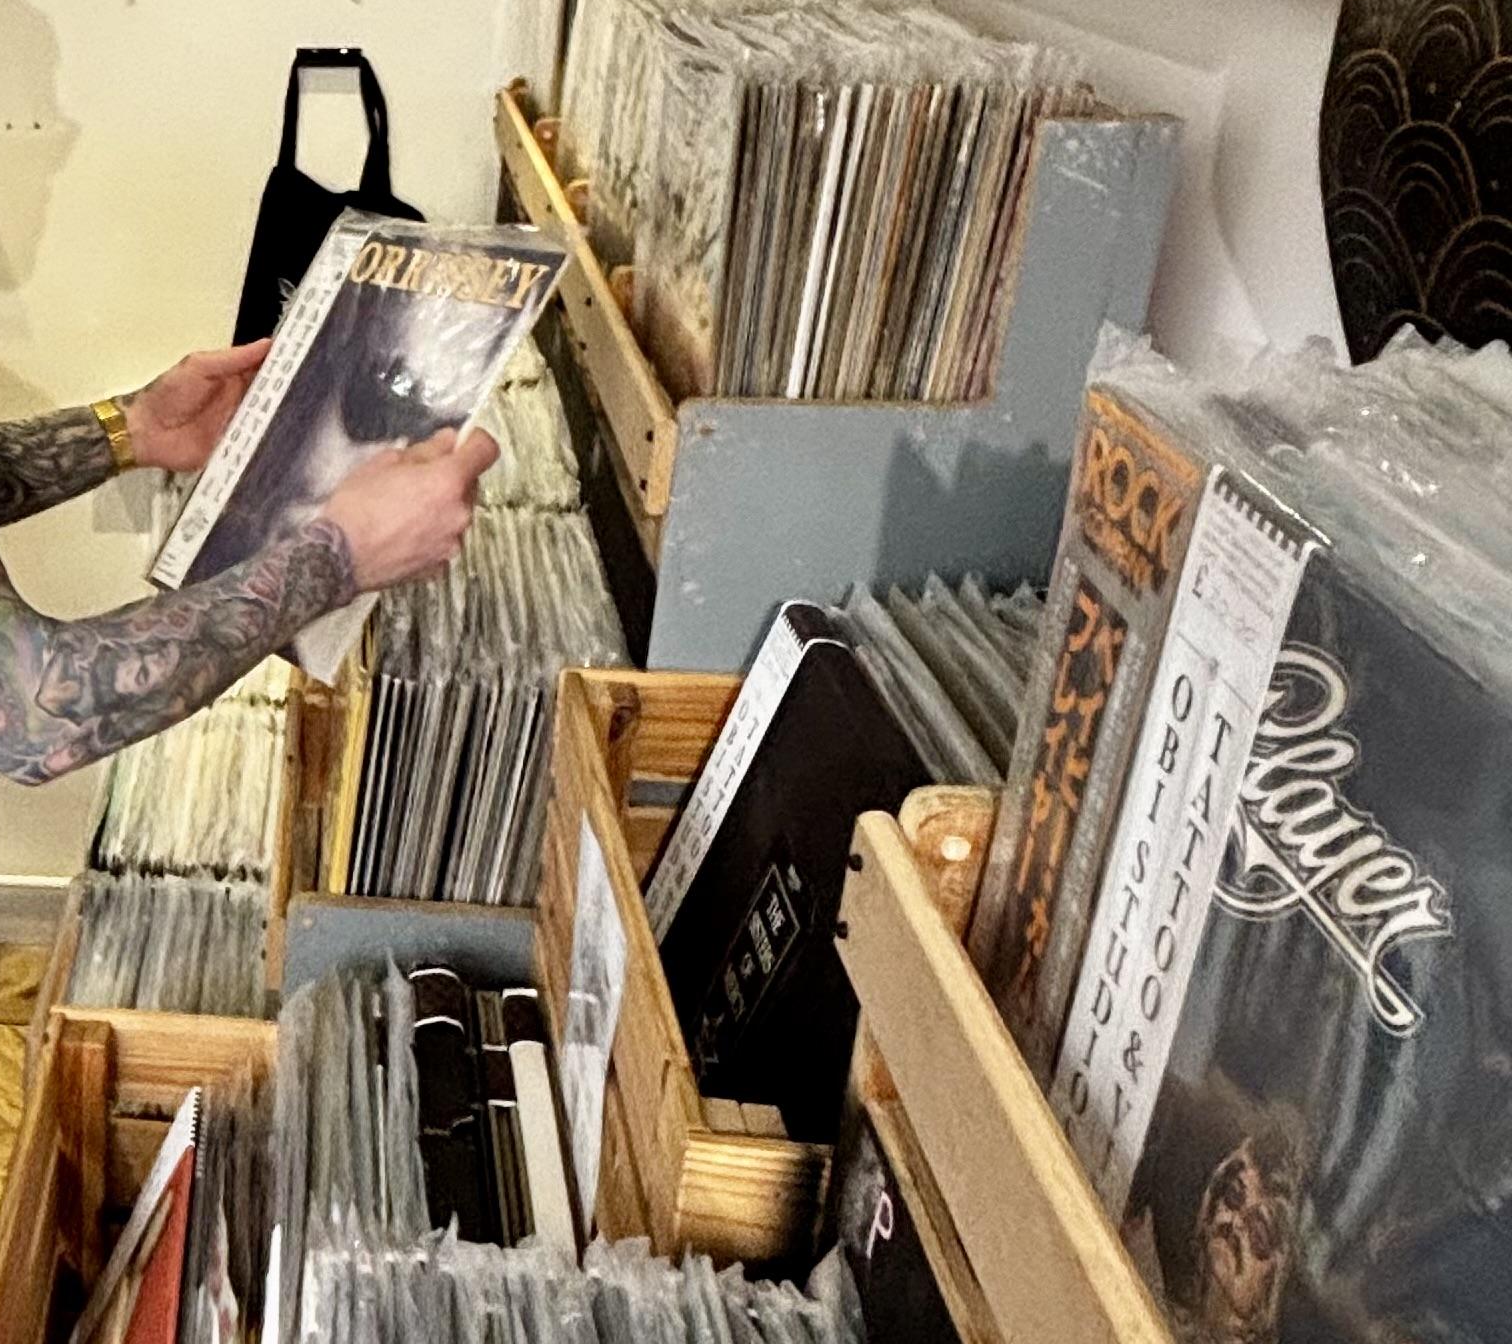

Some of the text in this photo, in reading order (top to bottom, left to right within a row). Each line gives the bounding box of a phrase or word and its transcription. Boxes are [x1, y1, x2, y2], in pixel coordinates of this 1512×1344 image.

[350, 241, 551, 309] ORRISSEY
[1085, 428, 1184, 569] ROCK
[1147, 673, 1193, 824] OBI
[1139, 712, 1233, 1023] TATTOO
[1214, 641, 1453, 1036] Player
[1122, 1029, 1144, 1082] &
